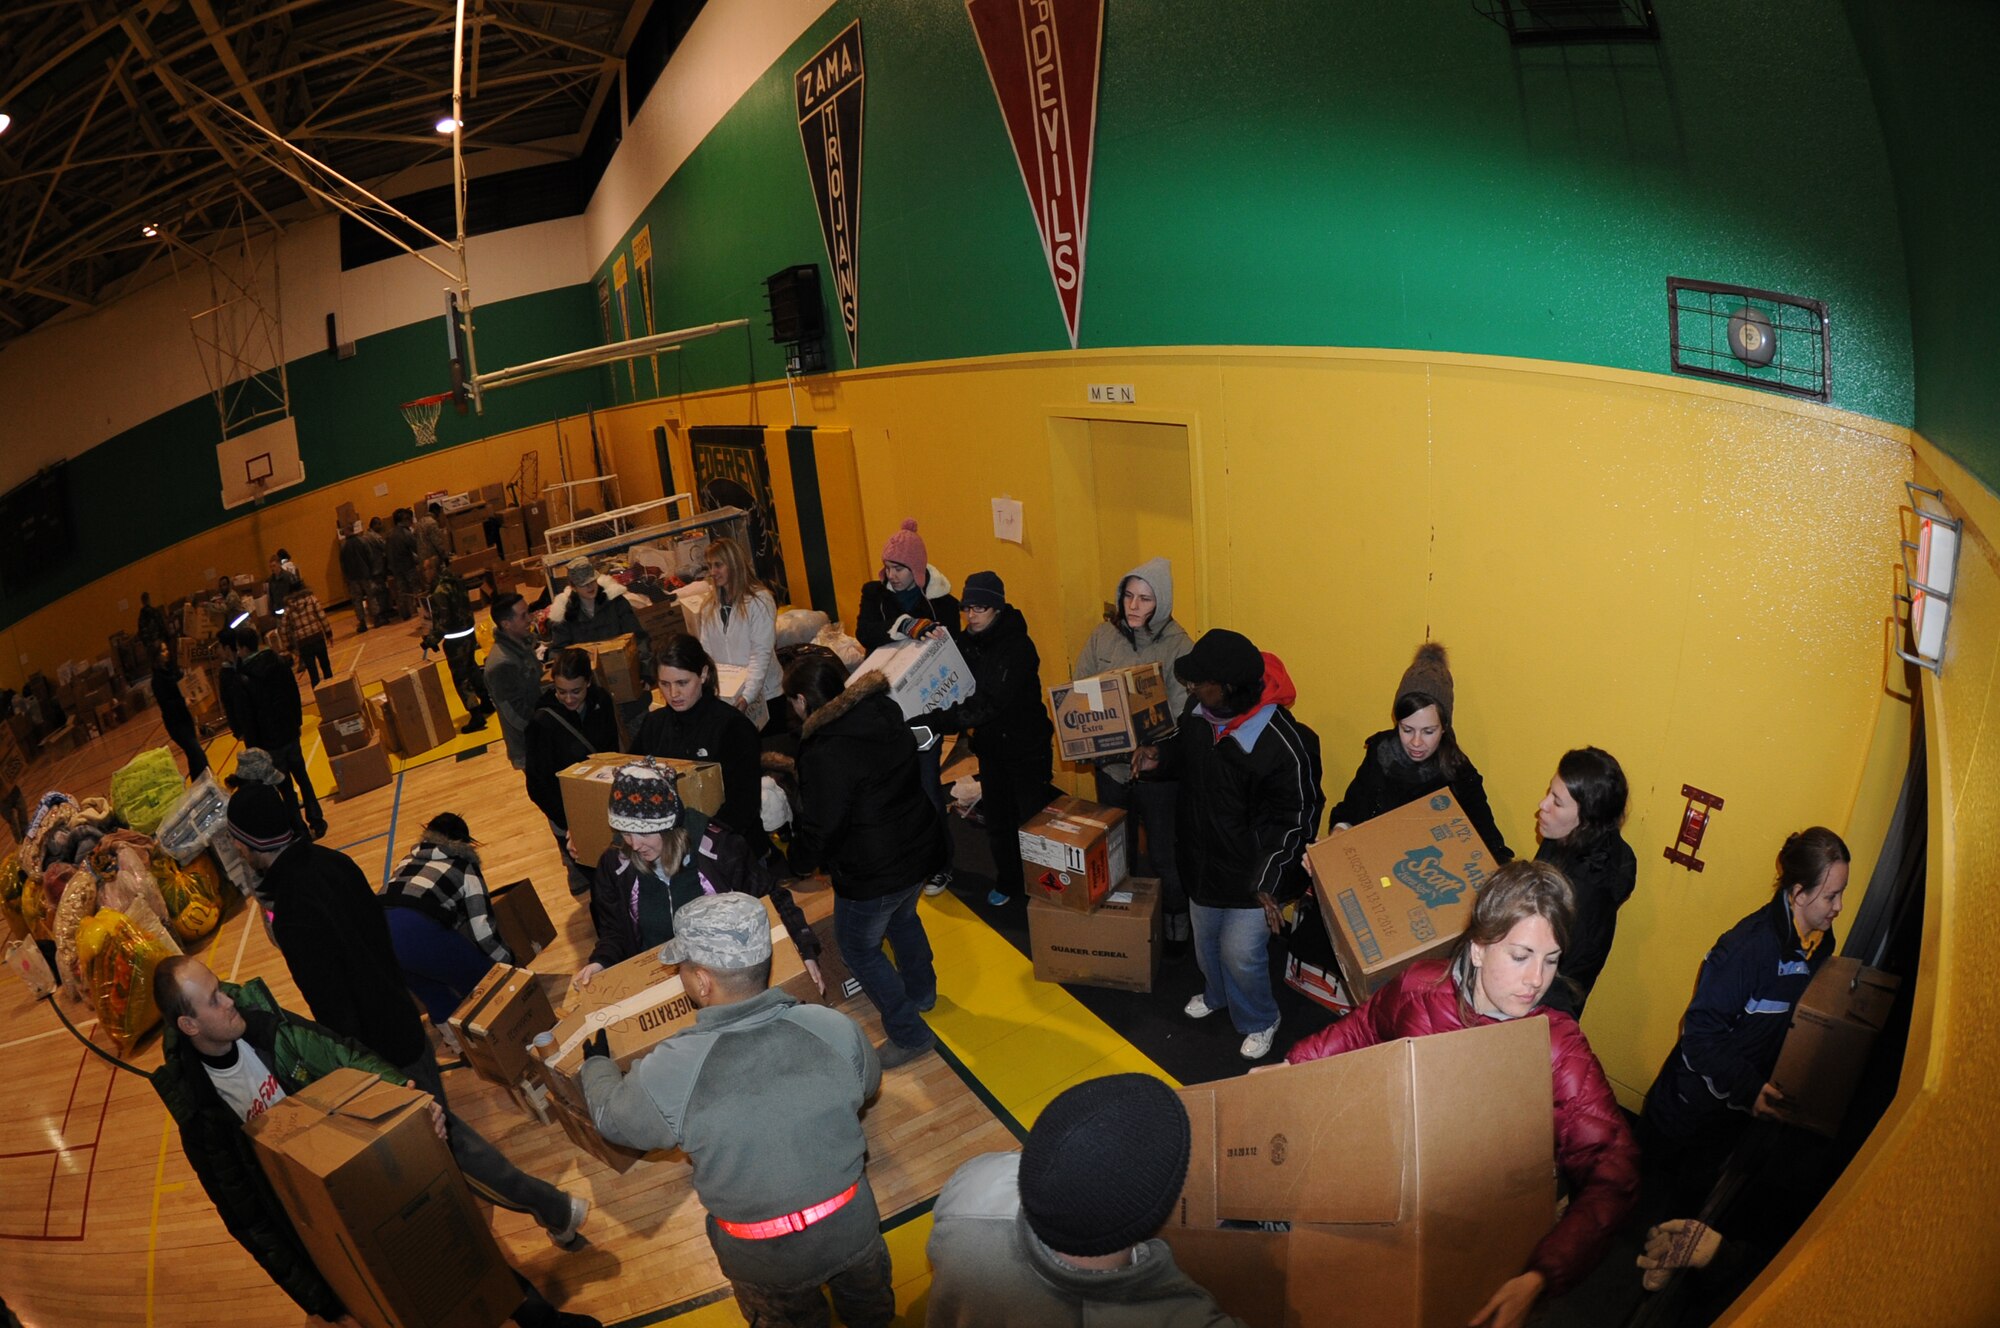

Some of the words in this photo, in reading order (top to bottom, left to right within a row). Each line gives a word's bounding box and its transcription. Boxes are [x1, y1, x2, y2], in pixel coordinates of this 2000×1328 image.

[803, 43, 852, 107] ZAMA
[1031, 24, 1077, 290] DEVILS
[825, 105, 855, 331] TROJANS
[1091, 387, 1130, 401] MEN
[922, 671, 959, 713] DIAMOND
[1063, 707, 1118, 731] Corona
[1081, 724, 1104, 734] Extra
[1408, 856, 1463, 894] Scott
[1462, 862, 1488, 893] 4413
[1099, 903, 1130, 911] EREAL
[1050, 945, 1089, 956] QUAKER
[1091, 950, 1128, 959] CEREAL
